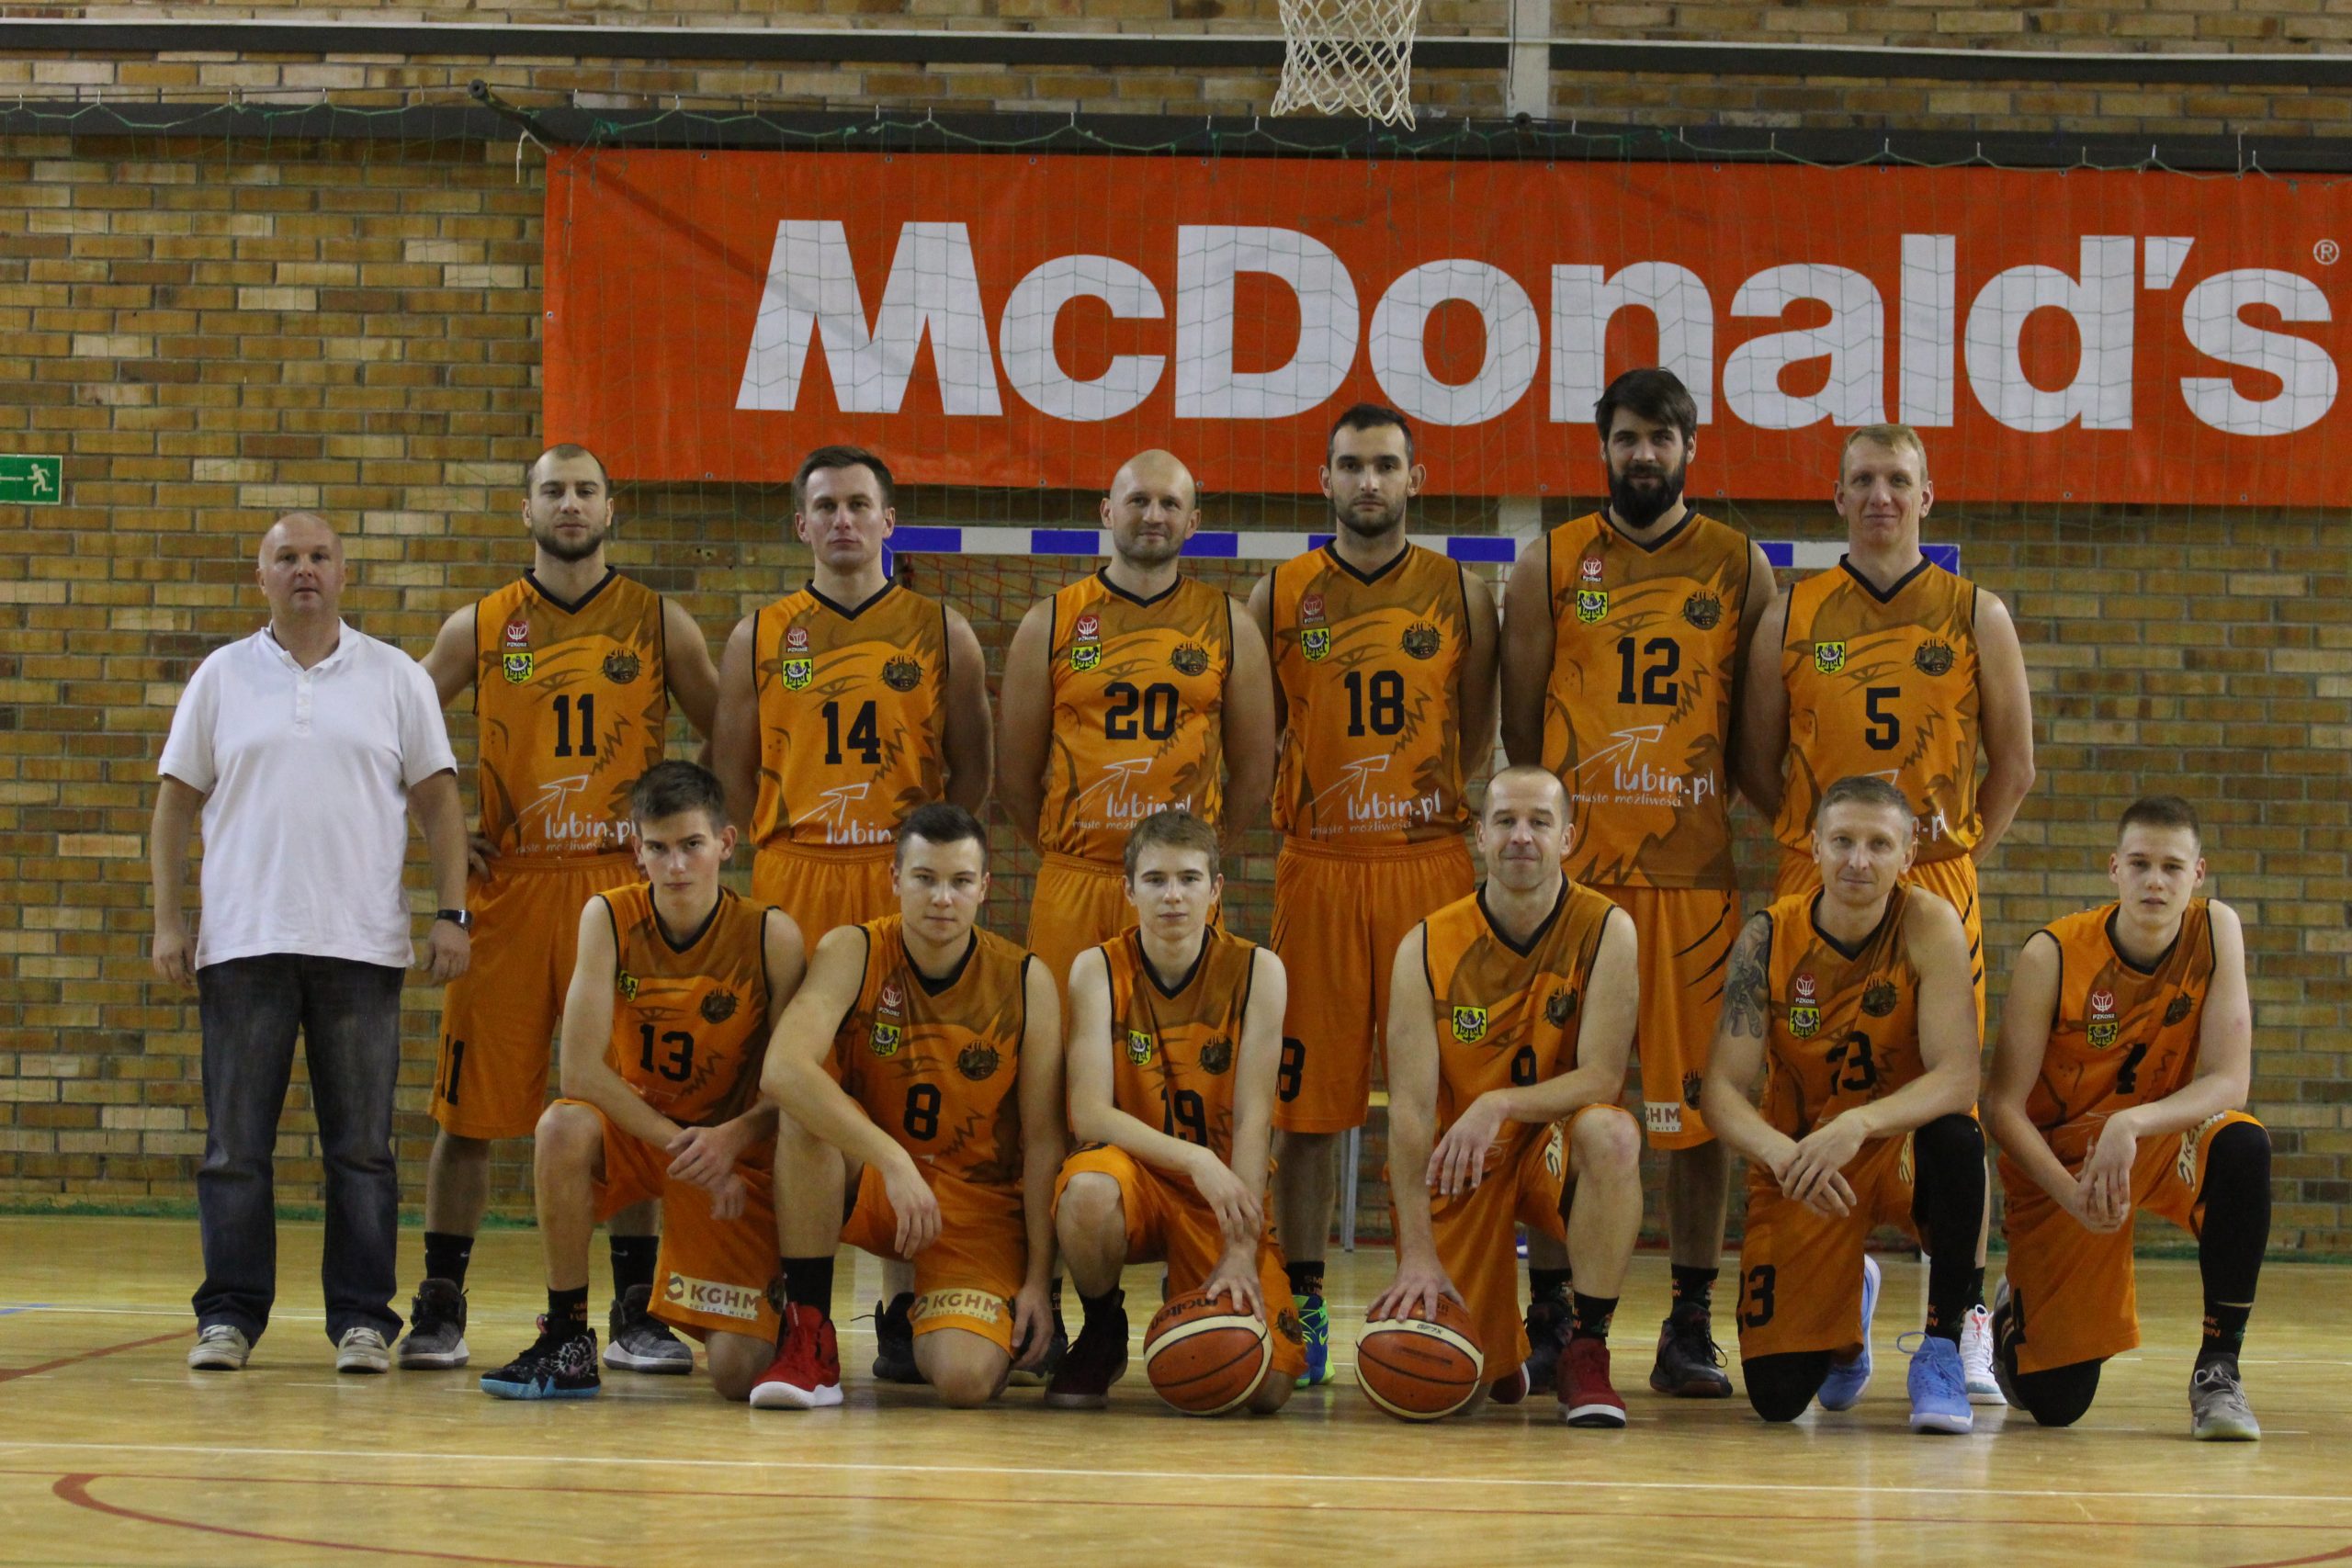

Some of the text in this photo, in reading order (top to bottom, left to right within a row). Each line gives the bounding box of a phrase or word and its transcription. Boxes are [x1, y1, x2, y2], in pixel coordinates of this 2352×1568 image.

[736, 220, 2338, 437] McDonald's
[1618, 637, 1679, 705] 12
[553, 694, 596, 757] 11
[822, 701, 880, 764] 14
[1104, 682, 1179, 740] 20
[1344, 671, 1404, 736] 18
[1866, 687, 1900, 750] 5
[1348, 788, 1441, 822] lubin.pl
[1572, 793, 1609, 804] miasto
[1614, 764, 1714, 806] lubin.pl
[546, 812, 636, 845] lubin.pl
[639, 1024, 694, 1084] 13
[903, 1083, 941, 1142] 8
[1161, 1087, 1209, 1148] 19
[690, 1283, 758, 1312] KGHM
[933, 1292, 1002, 1314] KGHM
